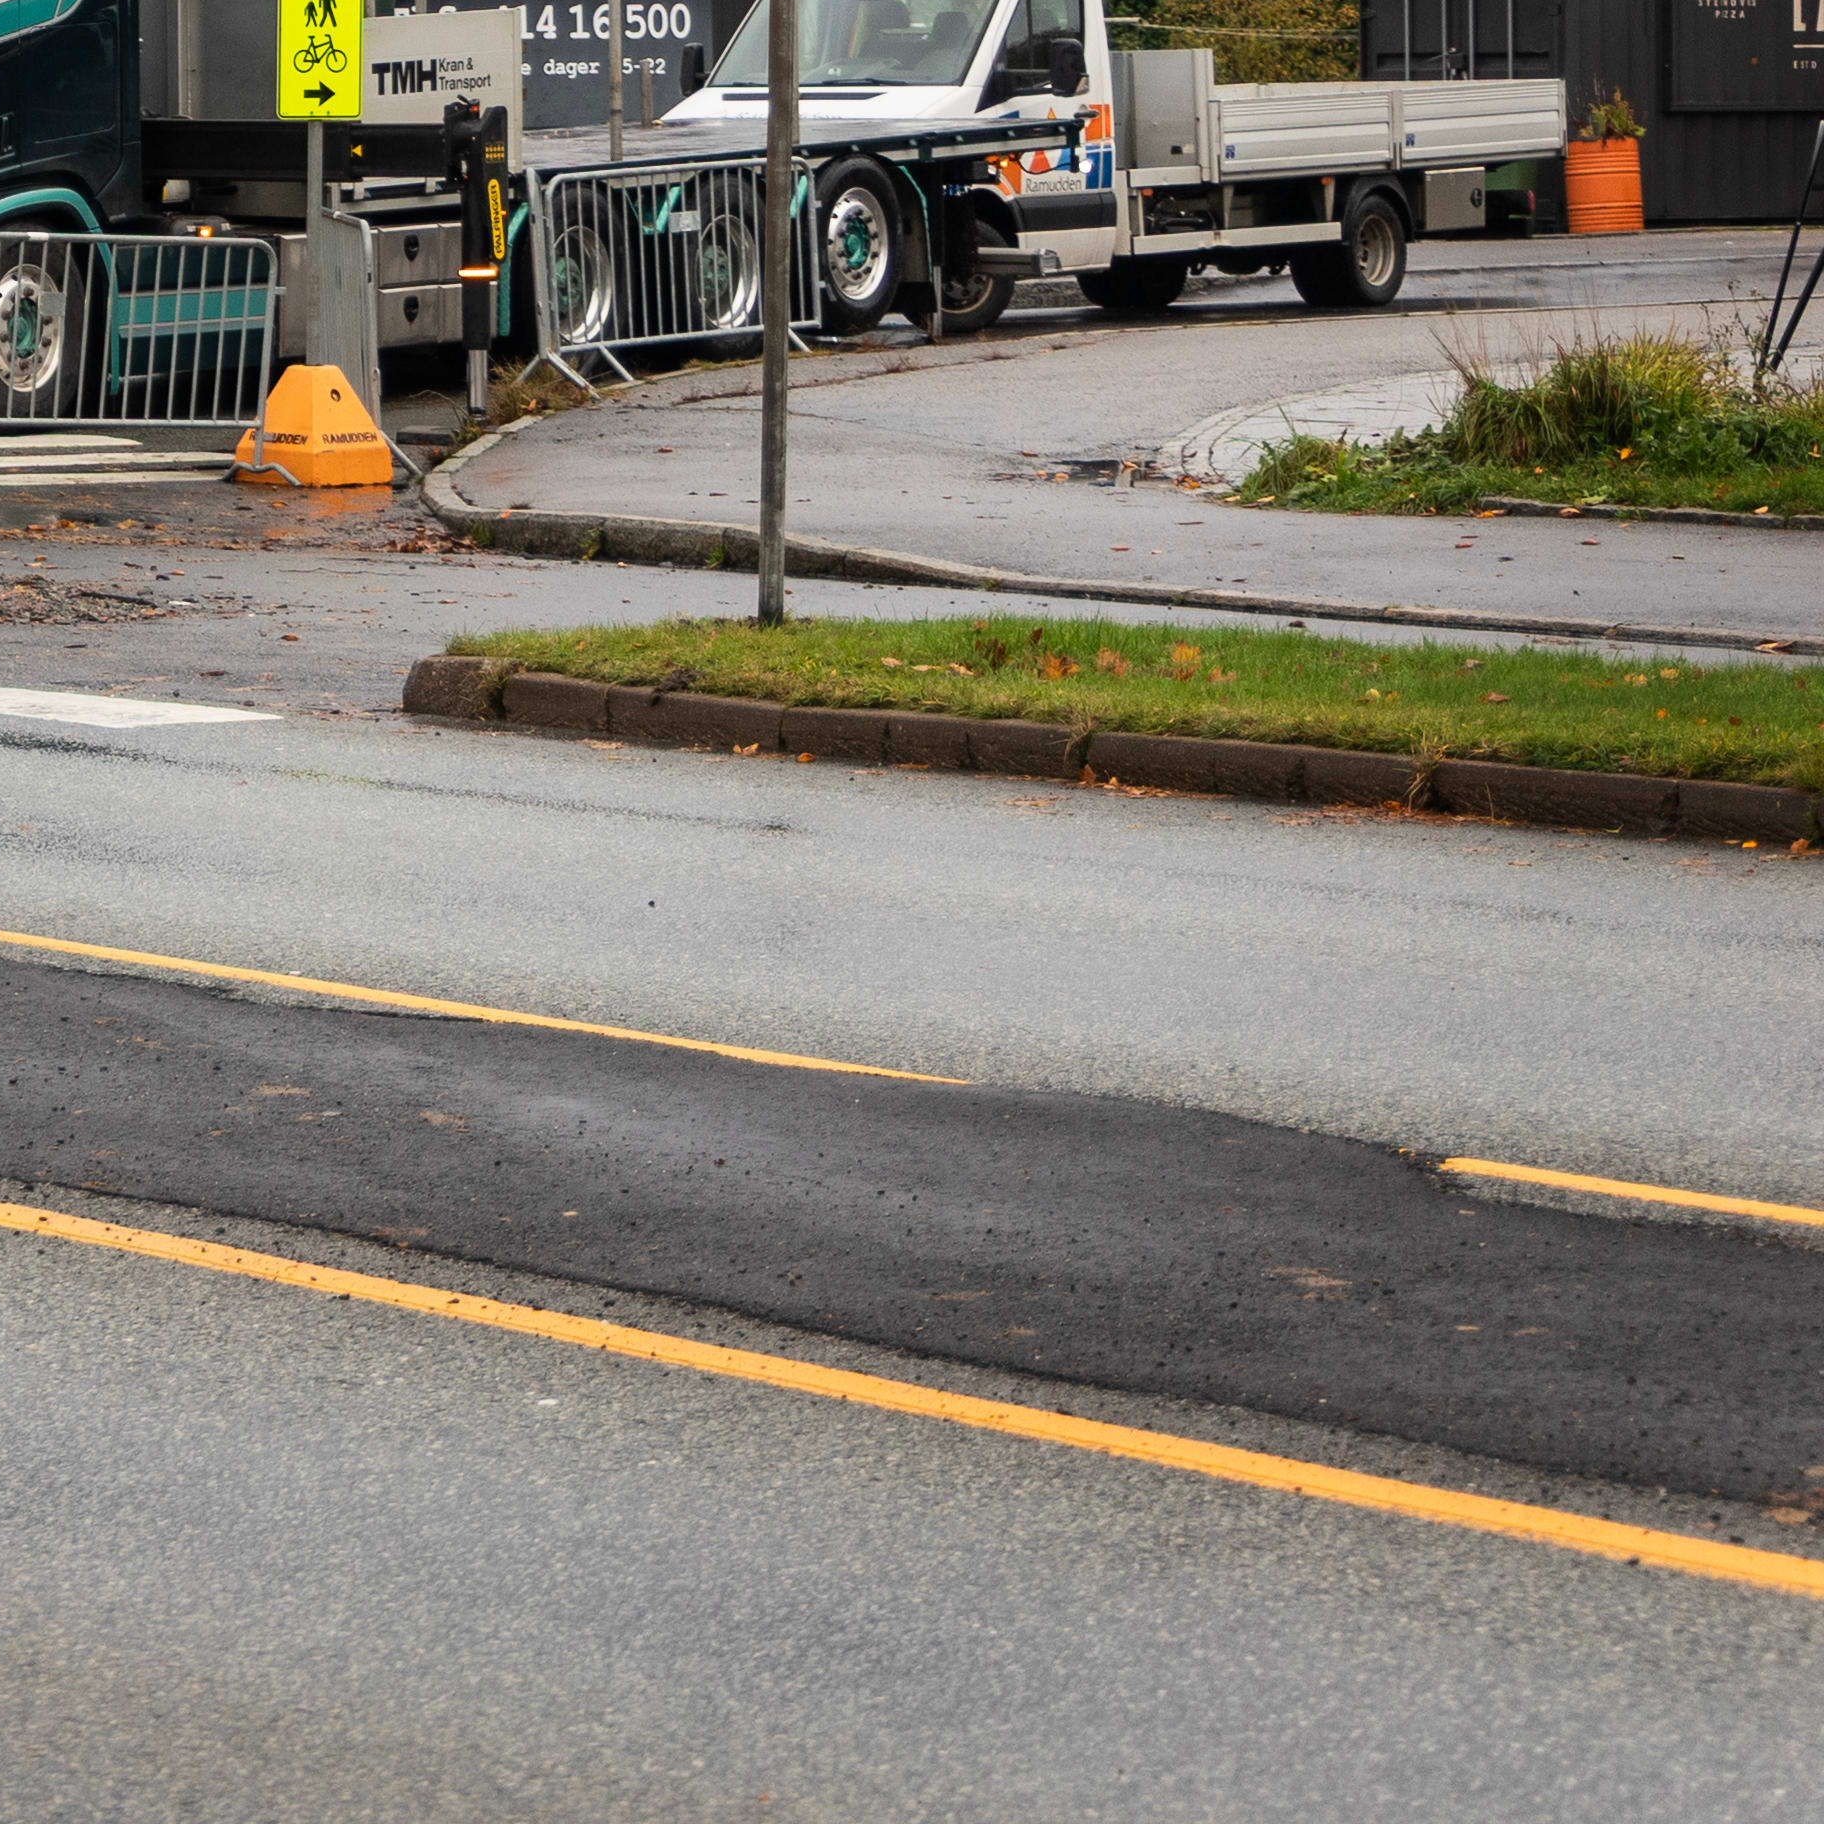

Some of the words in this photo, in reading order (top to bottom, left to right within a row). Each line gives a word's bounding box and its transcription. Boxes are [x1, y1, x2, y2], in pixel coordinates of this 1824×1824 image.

[499, 4, 556, 39] 14
[569, 5, 609, 39] 16
[625, 3, 692, 39] 500
[371, 59, 437, 96] TMH
[438, 58, 463, 72] Kran
[466, 57, 473, 70] &
[543, 58, 600, 79] dager
[618, 58, 666, 75] 5-22
[438, 76, 491, 91] Transport
[1025, 178, 1083, 192] Ramudden
[490, 184, 504, 254] PALFINGER
[249, 431, 308, 445] RUDDEN
[322, 432, 378, 444] RAMUDDEN
